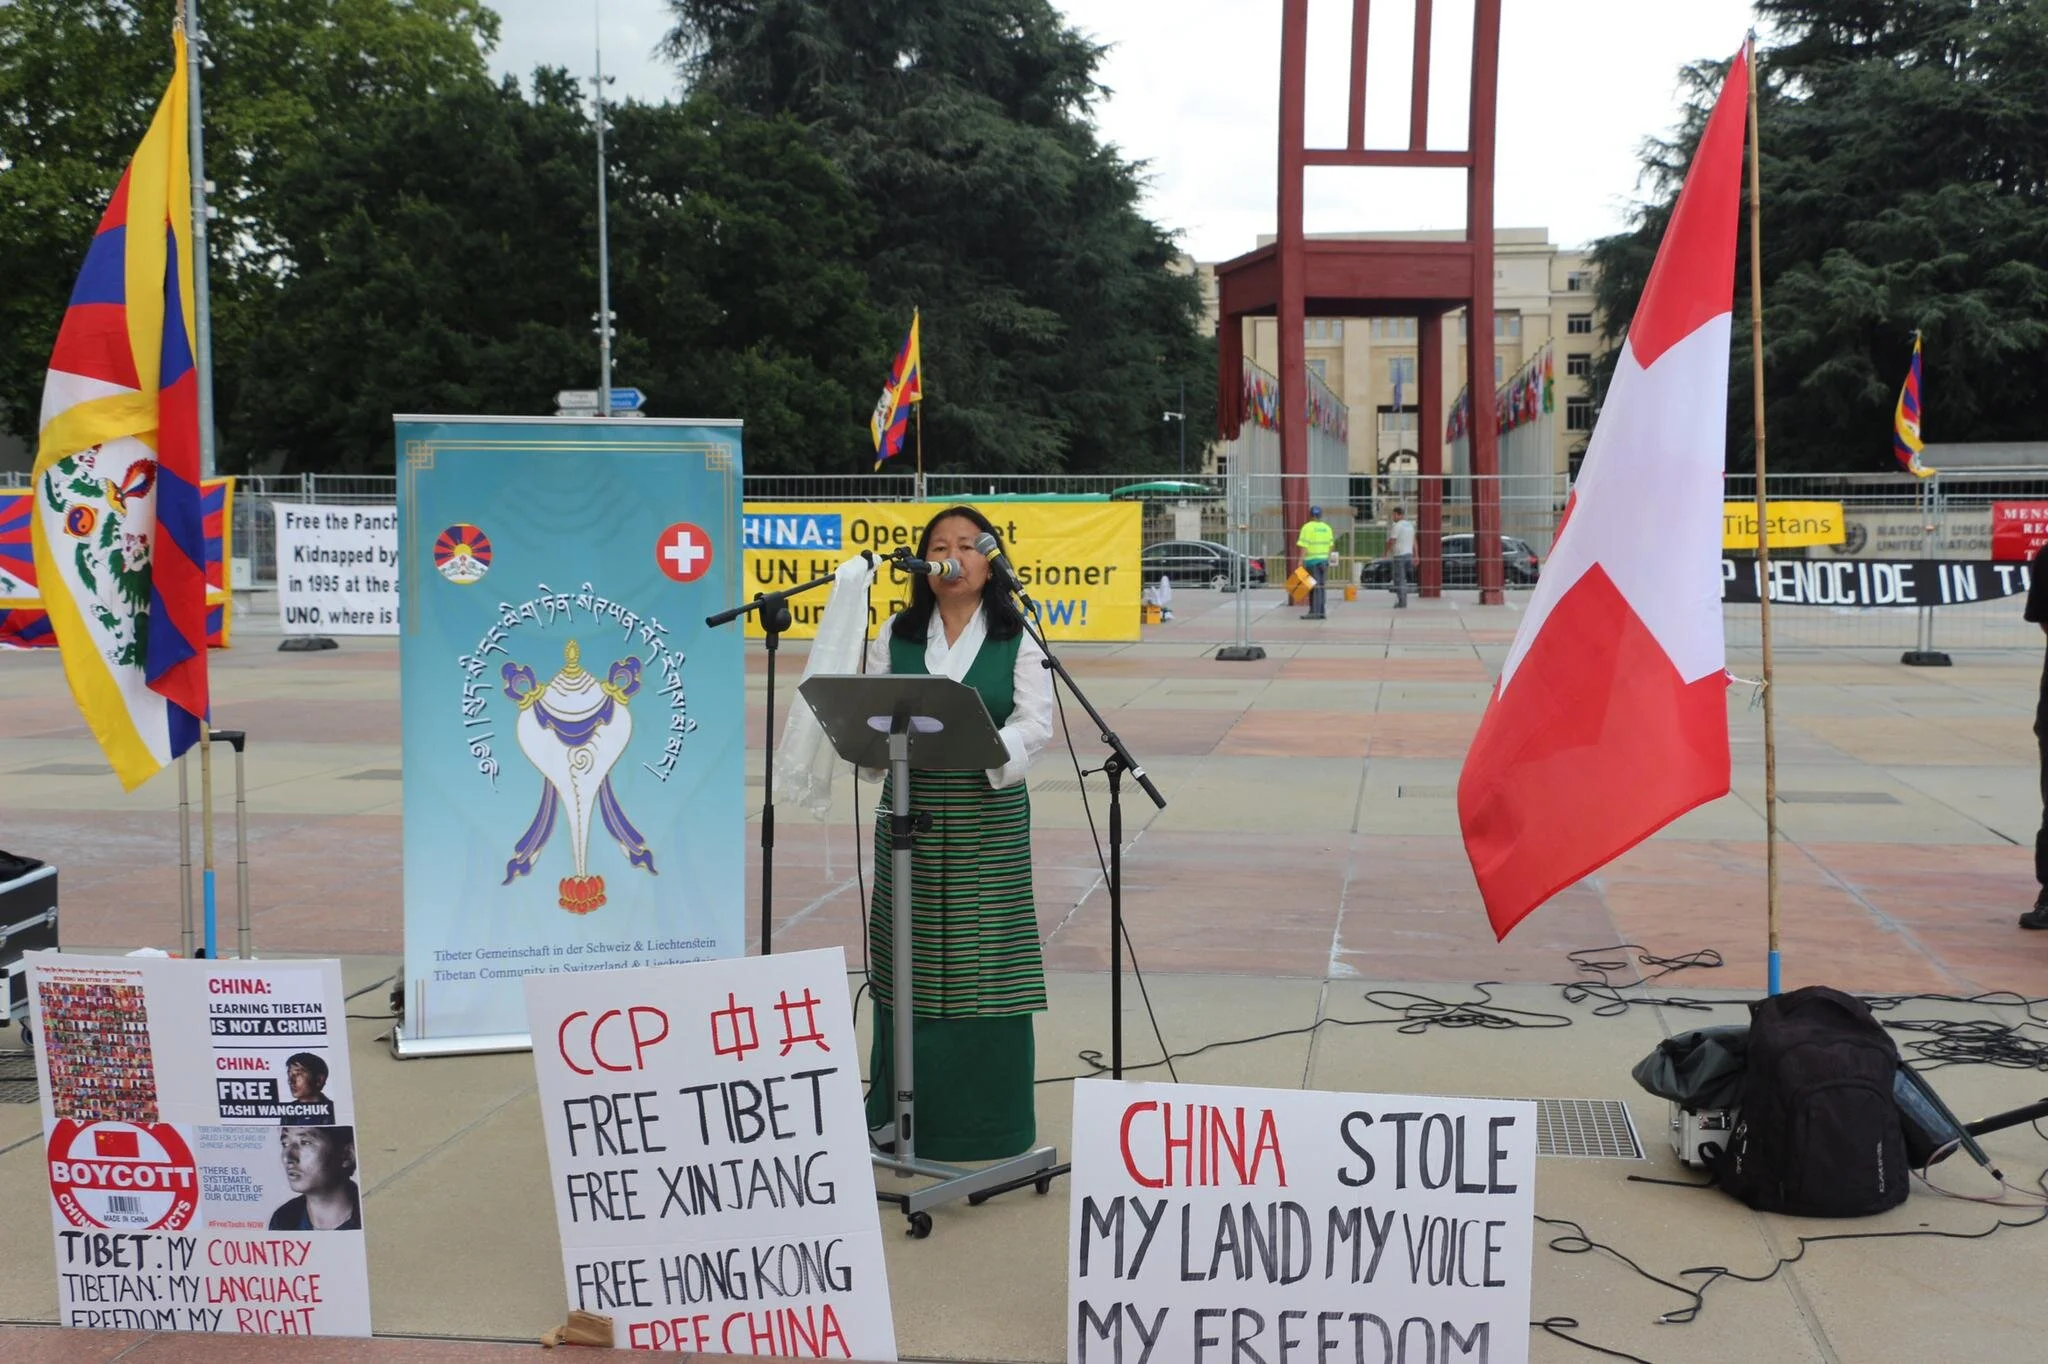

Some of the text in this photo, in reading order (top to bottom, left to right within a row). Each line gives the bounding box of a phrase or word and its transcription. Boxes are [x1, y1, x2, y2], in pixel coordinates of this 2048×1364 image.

[286, 512, 320, 529] Free
[326, 513, 349, 529] the
[743, 518, 835, 545] HINA:
[1723, 514, 1832, 535] Tibetans
[294, 545, 399, 567] Kidnapped by
[755, 558, 798, 584] UN
[1754, 560, 1918, 604] GENOCIDE
[1938, 563, 1978, 604] IN
[288, 575, 302, 592] in
[308, 575, 340, 592] 1995
[345, 576, 360, 592] at
[366, 575, 390, 592] the
[286, 607, 324, 627] UNO,
[329, 608, 375, 625] where
[380, 607, 392, 624] is
[433, 937, 717, 961] Tibeter Gemeinschaft in der Schweiz & Liechtenstein
[433, 969, 476, 981] Tibetan
[480, 966, 546, 979] Community
[549, 964, 560, 973] in
[208, 978, 272, 994] CHINA:
[209, 1003, 323, 1014] LEARNING TIBETAN
[211, 1019, 327, 1033] IS NOT A CRIME
[558, 1005, 669, 1075] CCP
[216, 1057, 270, 1070] CHINA:
[218, 1081, 273, 1100] FREE
[220, 1104, 329, 1116] TASHI WANGCHUK
[563, 1067, 838, 1157] FREE TIBET
[1120, 1100, 1518, 1194] CHINA STOLE
[51, 1161, 194, 1188] BOYCOTT
[203, 1175, 252, 1184] SYSTEMATIC
[231, 1167, 239, 1175] IS
[241, 1167, 247, 1175] A
[205, 1193, 221, 1201] OUR
[567, 1151, 836, 1223] FREE XINJANG
[1079, 1195, 1506, 1288] MY LAND MY VOICE
[168, 1237, 197, 1271] MY
[208, 1239, 312, 1267] COUNTRY
[169, 1275, 200, 1303] MY
[205, 1274, 323, 1304] LANGUAGE
[575, 1259, 653, 1310] FREE
[188, 1308, 223, 1332] MY
[236, 1307, 314, 1335] RIGHT
[722, 1303, 853, 1359] CHINA
[1078, 1300, 1490, 1364] MY FREEDOM
